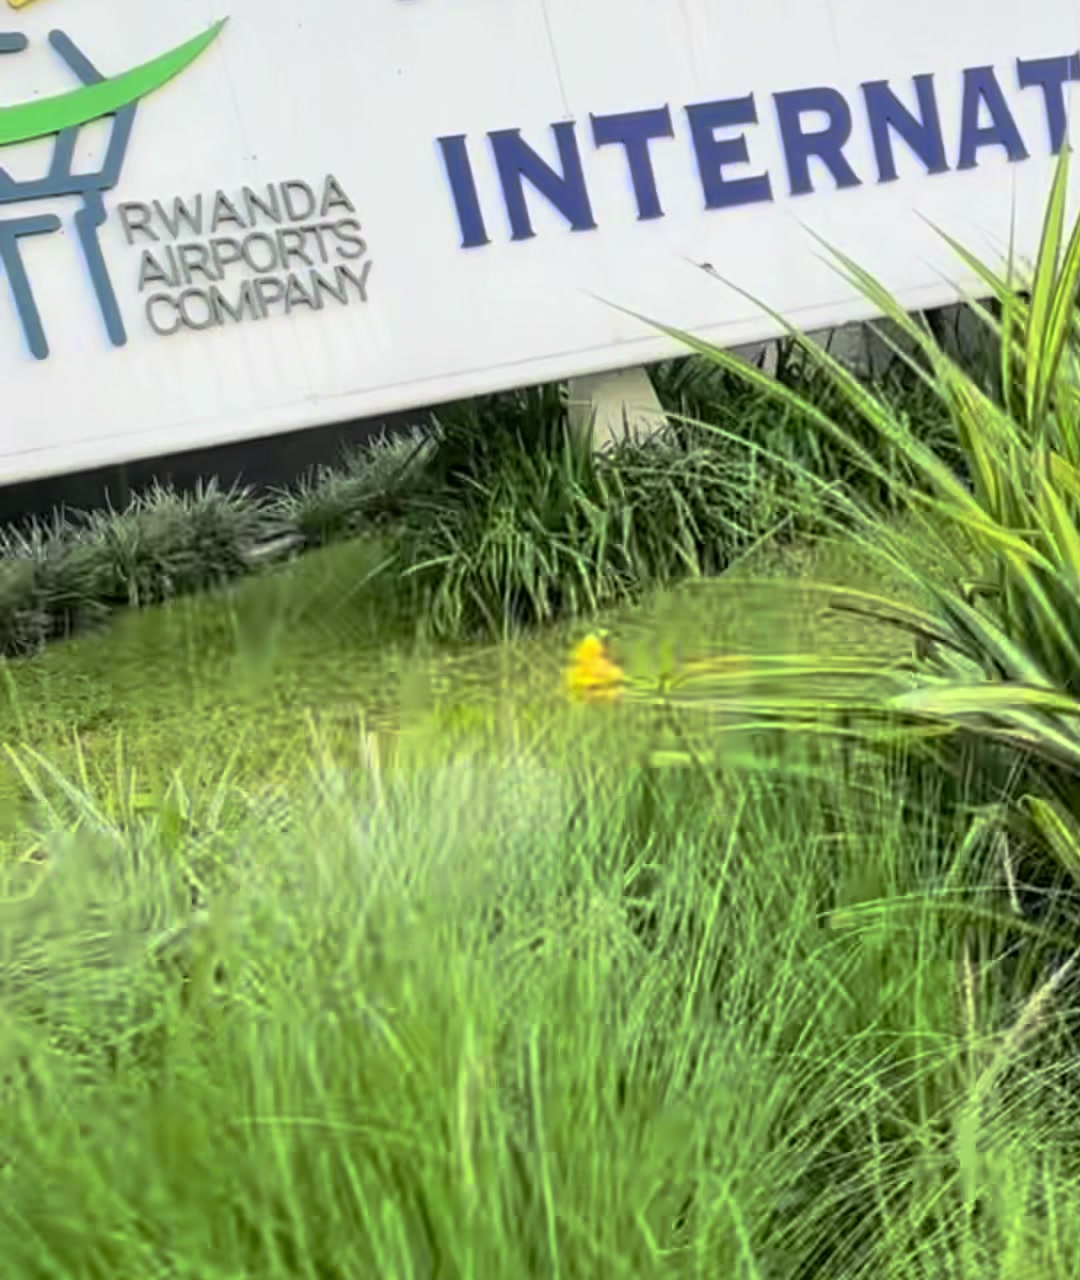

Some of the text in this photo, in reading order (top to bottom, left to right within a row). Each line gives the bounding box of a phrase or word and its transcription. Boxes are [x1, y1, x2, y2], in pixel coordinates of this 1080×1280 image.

[118, 174, 356, 246] RWANDA
[138, 218, 368, 292] AIRPORTS
[145, 260, 373, 336] COMPANY
